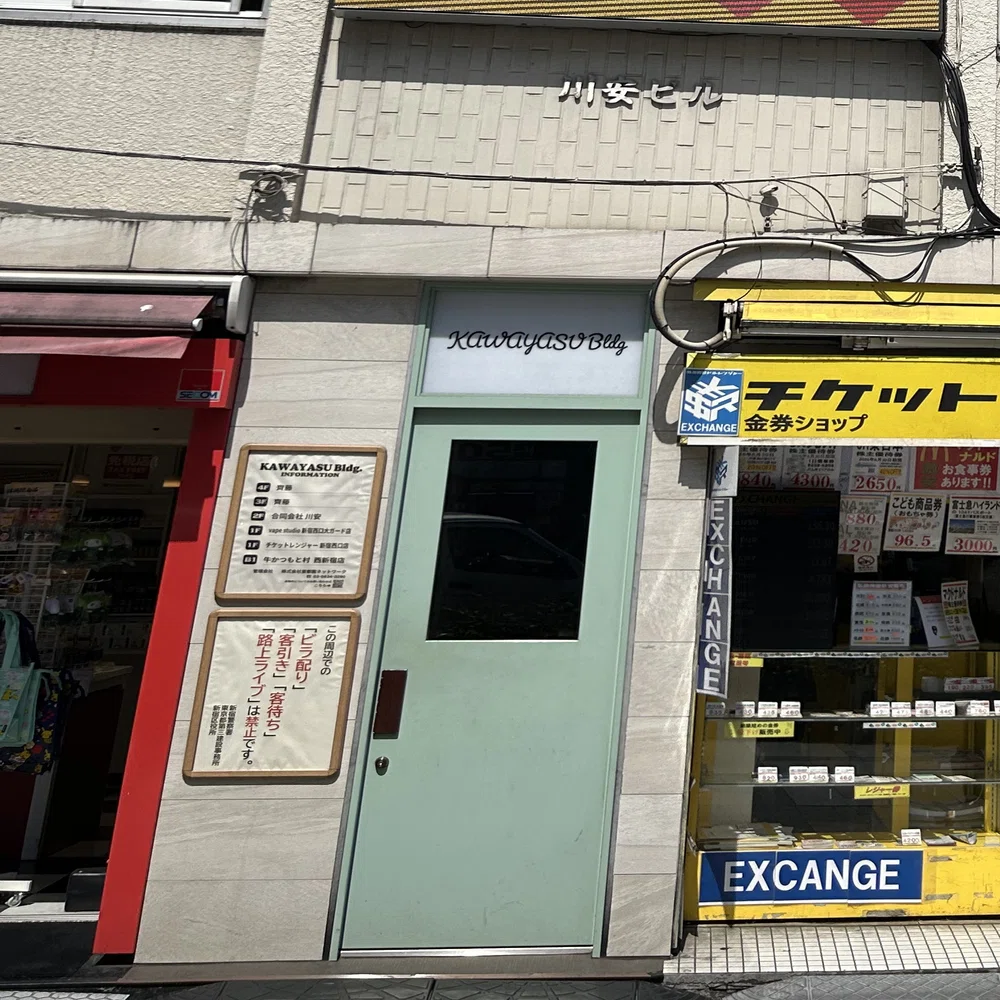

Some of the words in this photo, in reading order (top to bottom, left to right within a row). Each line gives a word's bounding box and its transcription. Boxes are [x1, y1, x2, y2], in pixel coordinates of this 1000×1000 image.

[558, 79, 724, 109] 川安ビル
[680, 421, 738, 433] EXCHANGE
[744, 413, 869, 433] 金券ショップ
[260, 462, 333, 472] KAWAYASU
[334, 464, 363, 474] Bldg.
[942, 464, 993, 476] お食事券
[892, 497, 943, 511] こども商品券
[952, 500, 1000, 511] 富士急ハイランド
[702, 499, 726, 693] EXCHANGE
[292, 627, 318, 690] 「ビラ配り」
[320, 625, 337, 676] この周辺での
[241, 628, 276, 765] 「路上ライブ」は禁止です。
[263, 628, 297, 738] 「客引き」「客待ち」
[723, 858, 900, 892] EXCANGE
